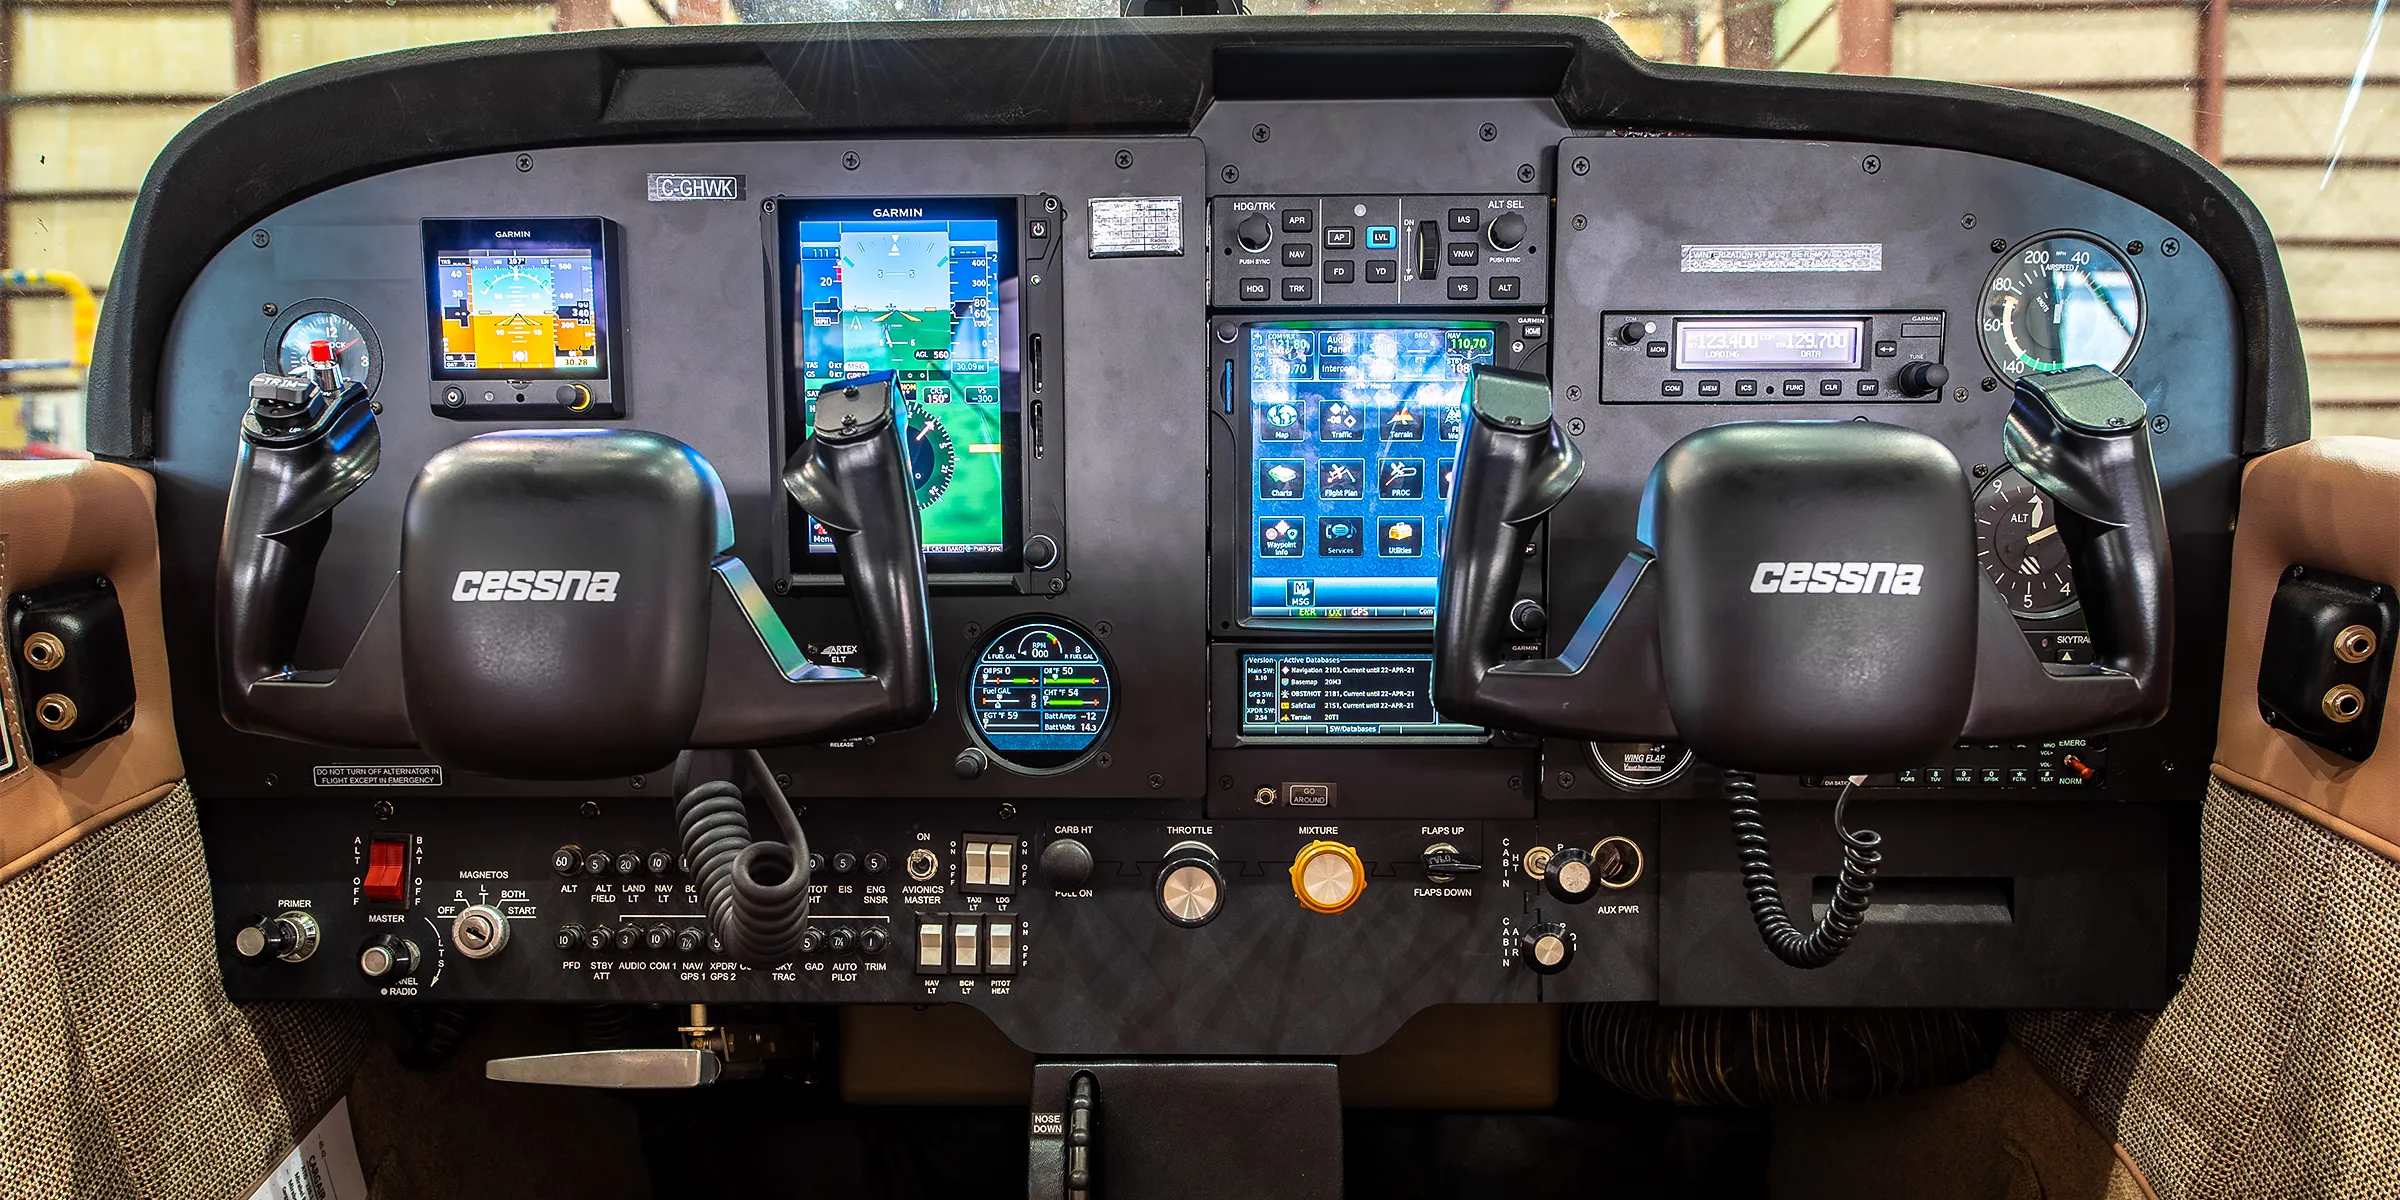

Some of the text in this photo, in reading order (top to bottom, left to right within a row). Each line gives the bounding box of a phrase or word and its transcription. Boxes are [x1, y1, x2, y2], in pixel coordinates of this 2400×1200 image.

[661, 179, 733, 197] C-GHWK
[1233, 202, 1276, 211] HDG/TRK
[1487, 200, 1525, 209] ALT SEL
[872, 208, 923, 218] GARMIN
[1288, 216, 1306, 224] APR
[1457, 215, 1471, 223] IAS
[1334, 233, 1345, 241] AP
[1374, 233, 1388, 241] LVL
[1288, 250, 1306, 258] NAV
[1453, 250, 1474, 258] VNAV
[2024, 251, 2050, 264] 200
[2071, 251, 2090, 265] 40
[1375, 267, 1387, 275] YD
[820, 277, 833, 287] 20
[972, 279, 986, 287] 300
[1992, 277, 2012, 291] 180
[1246, 285, 1264, 293] HDG
[1288, 285, 1305, 293] TRK
[1457, 284, 1469, 292] VS
[1498, 284, 1513, 292] ALT
[326, 326, 338, 338] 12
[1451, 338, 1487, 349] 110.70
[1698, 332, 1759, 349] 123.400
[1786, 332, 1847, 349] 129.700
[915, 351, 949, 359] AGL 560
[360, 355, 370, 366] 3
[564, 358, 588, 366] 30.28
[2003, 360, 2025, 374] 140
[263, 376, 299, 389] TRIM
[1275, 431, 1290, 439] Map
[1331, 430, 1353, 439] Traffic
[1390, 431, 1413, 439] Terrain
[1992, 479, 2003, 493] 9
[1271, 489, 1292, 497] Charts
[1392, 489, 1411, 497] PROC
[2010, 513, 2029, 523] ALT
[1327, 547, 1354, 555] Services
[1749, 561, 1925, 596] cessna
[451, 570, 621, 602] cessna
[2059, 582, 2071, 597] 4
[2023, 594, 2033, 608] 5
[1031, 648, 1049, 658] 000
[1291, 667, 1323, 675] Navigation
[1068, 688, 1079, 697] 54
[1044, 723, 1097, 731] Batt Volts 14.3
[2058, 739, 2087, 747] EMERG
[1624, 753, 1666, 763] WING FLAP
[383, 767, 430, 775] ALTERNATOR
[388, 776, 435, 784] EMERGENCY
[2059, 777, 2083, 785] NORM
[1303, 787, 1316, 795] GO
[1293, 796, 1325, 804] AROUND
[1054, 825, 1094, 834] CARB HT
[1167, 826, 1213, 835] THROTTLE
[1298, 826, 1339, 835] MIXTURE
[1421, 826, 1465, 835] FLAPS UP
[916, 832, 931, 841] ON
[459, 870, 509, 880] MAGNETOS
[560, 884, 578, 893] ALT
[595, 884, 613, 893] ALT
[622, 884, 646, 893] LAND
[654, 884, 674, 893] NAV
[838, 885, 853, 894] EIS
[866, 885, 886, 894] ENG
[902, 885, 944, 894] AVIONICS
[1414, 887, 1472, 897] FLAPS DOWN
[501, 890, 526, 899] BOTH
[1079, 889, 1093, 898] ON
[278, 899, 312, 908] PRIMER
[591, 895, 616, 903] FIELD
[658, 895, 669, 903] LT
[863, 895, 889, 904] SNSR
[904, 896, 941, 904] MASTER
[966, 896, 982, 904] TAXI
[995, 896, 1010, 904] LDG
[437, 906, 456, 915] OFF
[508, 906, 536, 915] START
[1597, 904, 1640, 914] AUX PWR
[368, 914, 405, 923] MASTER
[562, 962, 581, 970] PFD
[590, 962, 614, 970] STBY
[618, 962, 647, 970] AUDIO
[649, 962, 671, 970] COM
[804, 963, 825, 971] GAD
[832, 963, 858, 971] AUTO
[865, 963, 887, 971] TRIM
[593, 972, 611, 981] ATT
[680, 972, 700, 981] GPS
[771, 973, 796, 981] TRAC
[831, 973, 858, 982] PILOT
[924, 979, 940, 987] NAV
[959, 979, 975, 987] BCN
[991, 979, 1012, 987] PITOT
[389, 987, 417, 996] RADIO
[991, 987, 1011, 995] HEAT
[1034, 1114, 1061, 1124] NOSE
[1033, 1124, 1062, 1134] DOWN
